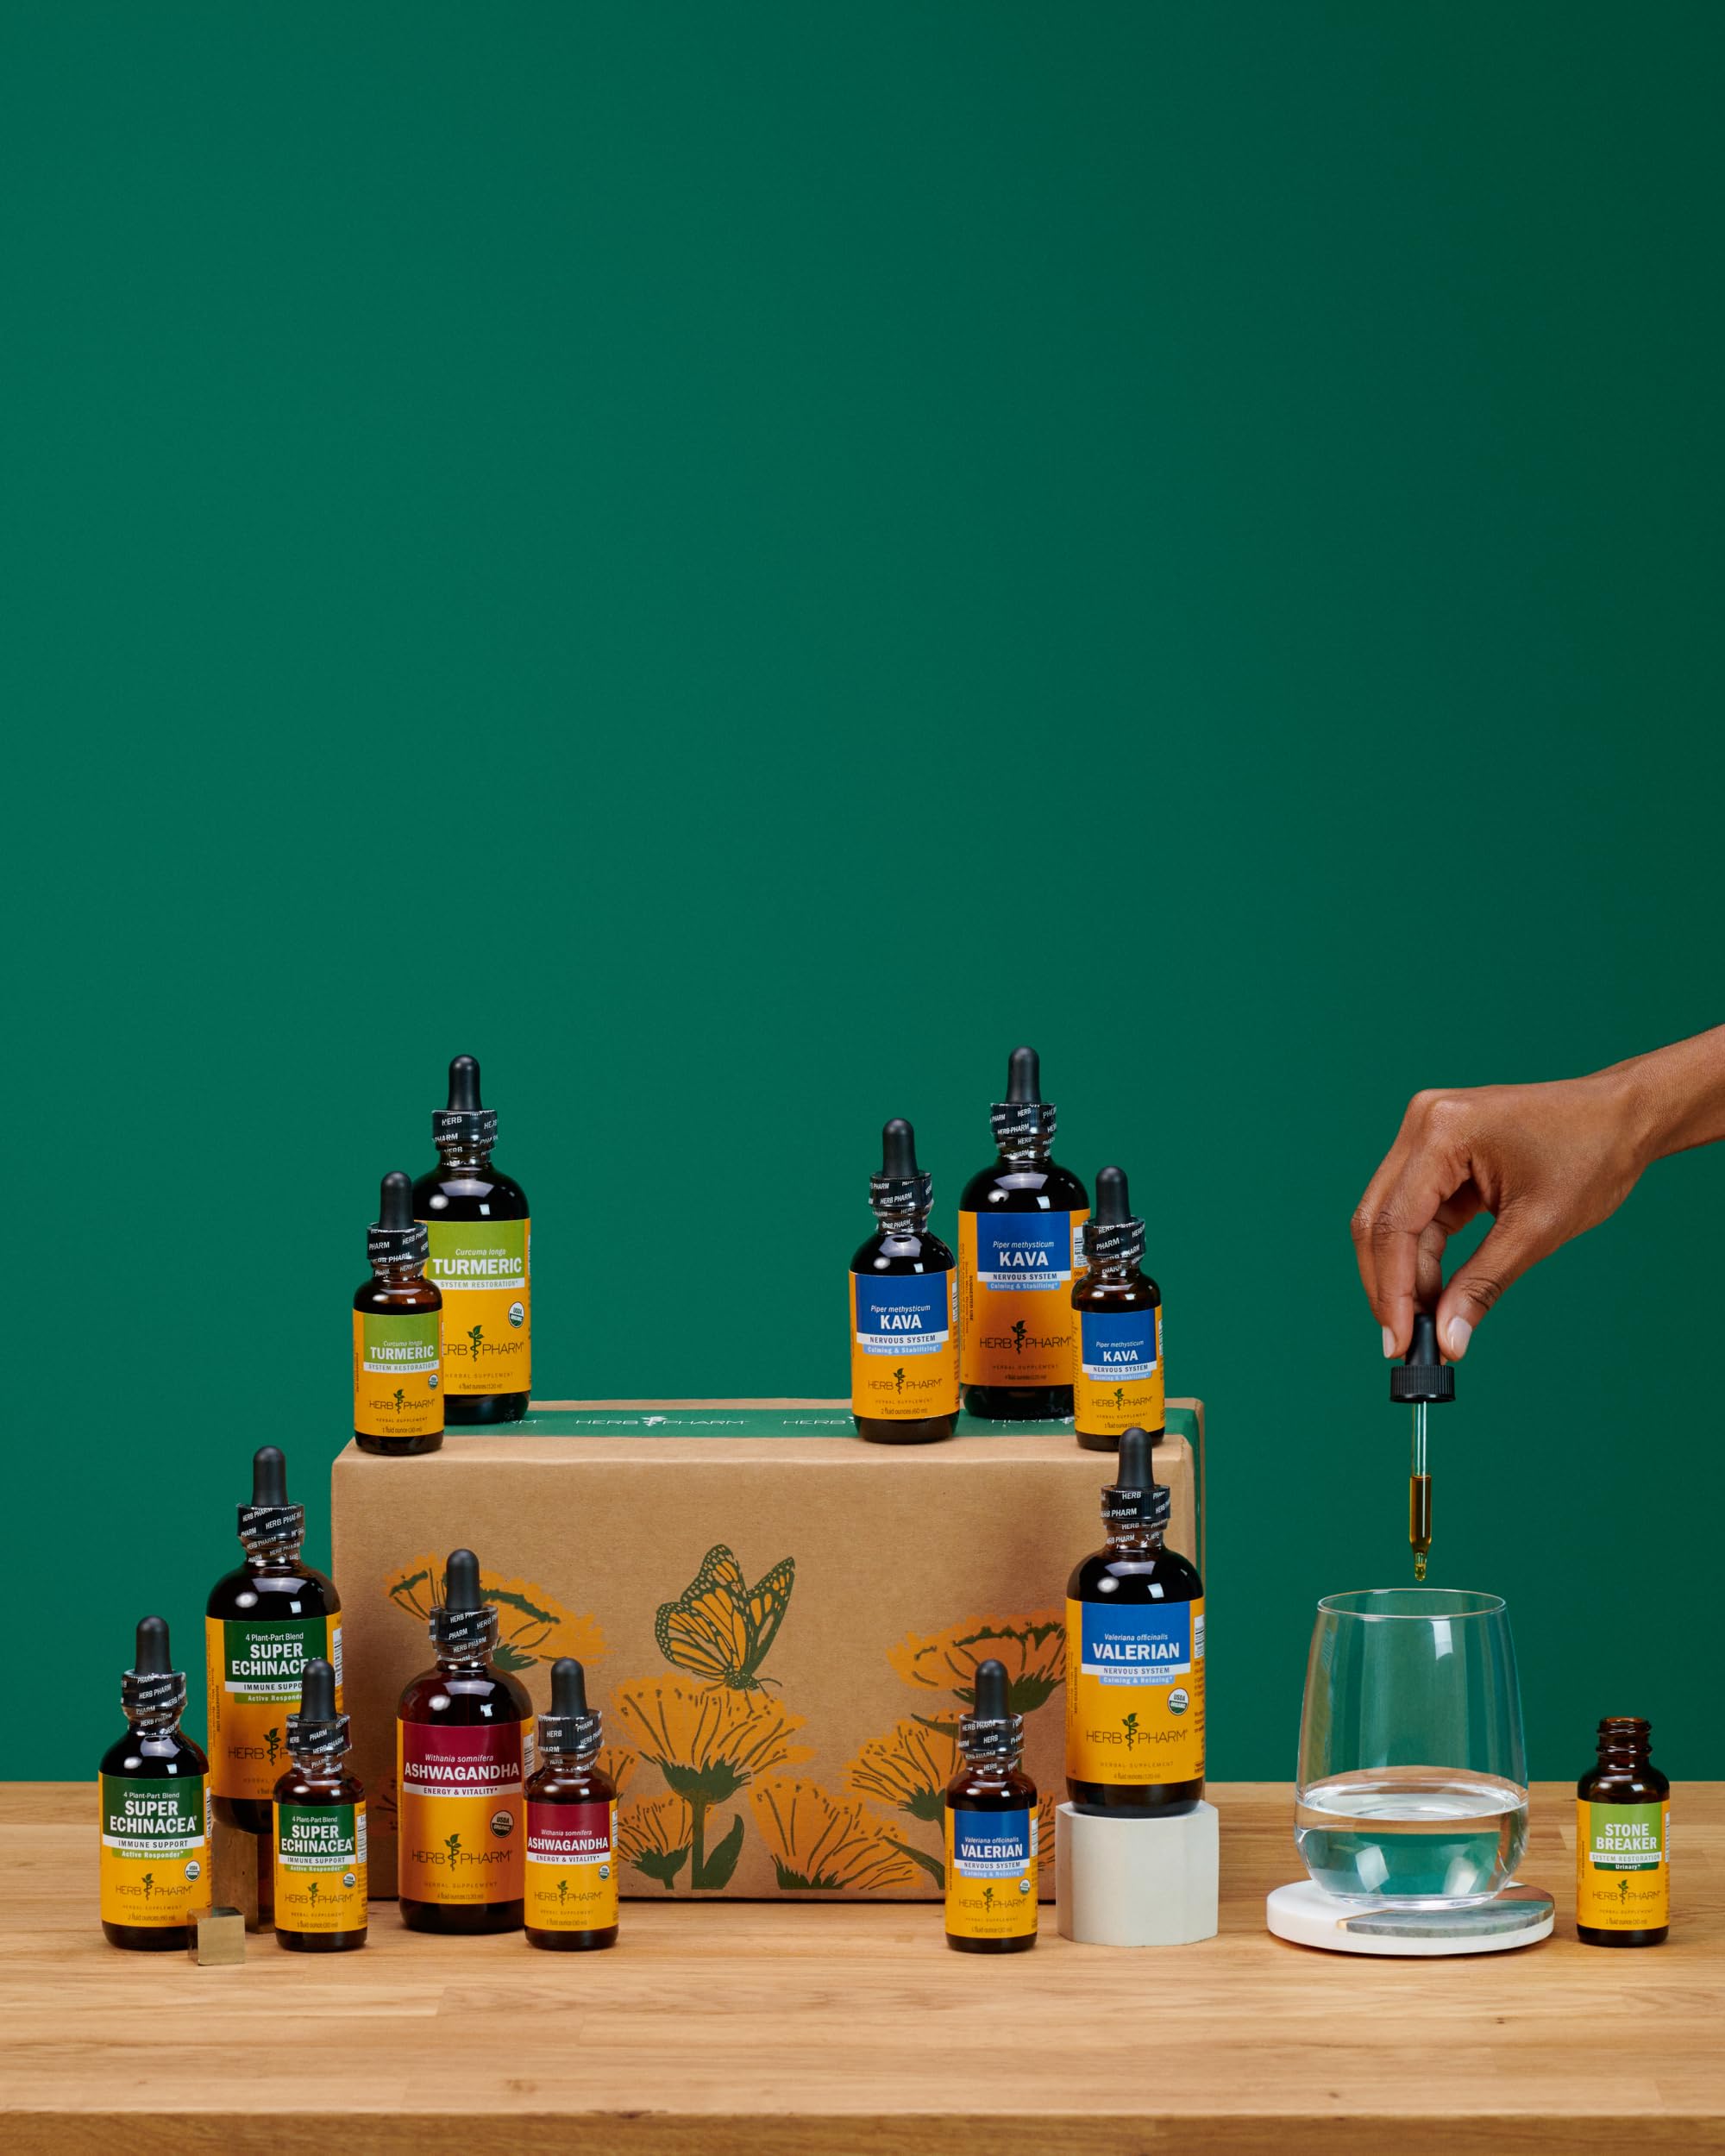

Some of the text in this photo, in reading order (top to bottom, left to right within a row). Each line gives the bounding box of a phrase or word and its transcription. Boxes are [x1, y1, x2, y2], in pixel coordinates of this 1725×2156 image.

[1018, 1108, 1031, 1117] HERB
[442, 1116, 462, 1125] HERB
[894, 1192, 913, 1202] PHARM
[369, 1242, 389, 1250] PHARM
[1096, 1238, 1120, 1250] PHARM
[1000, 1251, 1049, 1266] KAVA
[433, 1257, 522, 1275] TURMERIC
[871, 1305, 887, 1313] Piper
[881, 1314, 922, 1329] KAVA
[980, 1338, 1012, 1349] HERB
[371, 1345, 434, 1360] TURMERIC
[443, 1344, 467, 1355] ERB
[868, 1346, 892, 1355] Calming
[1103, 1351, 1138, 1362] KAVA
[868, 1380, 894, 1390] HERB
[369, 1401, 393, 1409] HERB
[242, 1507, 273, 1521] HERB PHARM
[1112, 1507, 1137, 1517] PHARM
[266, 1519, 281, 1530] HERB
[450, 1614, 464, 1623] HERB
[477, 1618, 491, 1629] HERB
[448, 1628, 467, 1639] PHARM
[250, 1643, 303, 1658] SUPER
[453, 1637, 486, 1653] HERB PHARM
[1093, 1643, 1179, 1660] VALERIAN
[232, 1658, 309, 1676] ECHINACE
[154, 1683, 171, 1696] PHARM
[310, 1729, 327, 1741] PHARM
[983, 1735, 998, 1744] HERB
[1087, 1731, 1122, 1744] HERB
[229, 1747, 264, 1759] HERB
[425, 1753, 455, 1762] Withania
[405, 1762, 519, 1781] ASHWAGANDHA
[125, 1801, 178, 1816] SUPER
[292, 1825, 339, 1839] SUPER
[1605, 1824, 1649, 1837] STONE
[118, 1839, 149, 1848] IMMUNE
[529, 1837, 608, 1851] ASHWAGANDHA
[1596, 1837, 1657, 1850] BREAKER
[961, 1844, 1022, 1858] VALERIAN
[412, 1850, 445, 1864] HERB
[116, 1885, 141, 1895] HERB
[285, 1894, 308, 1903] HERB
[535, 1891, 557, 1901] HERB
[1593, 1891, 1618, 1901] HERB
[959, 1899, 982, 1908] HERB
